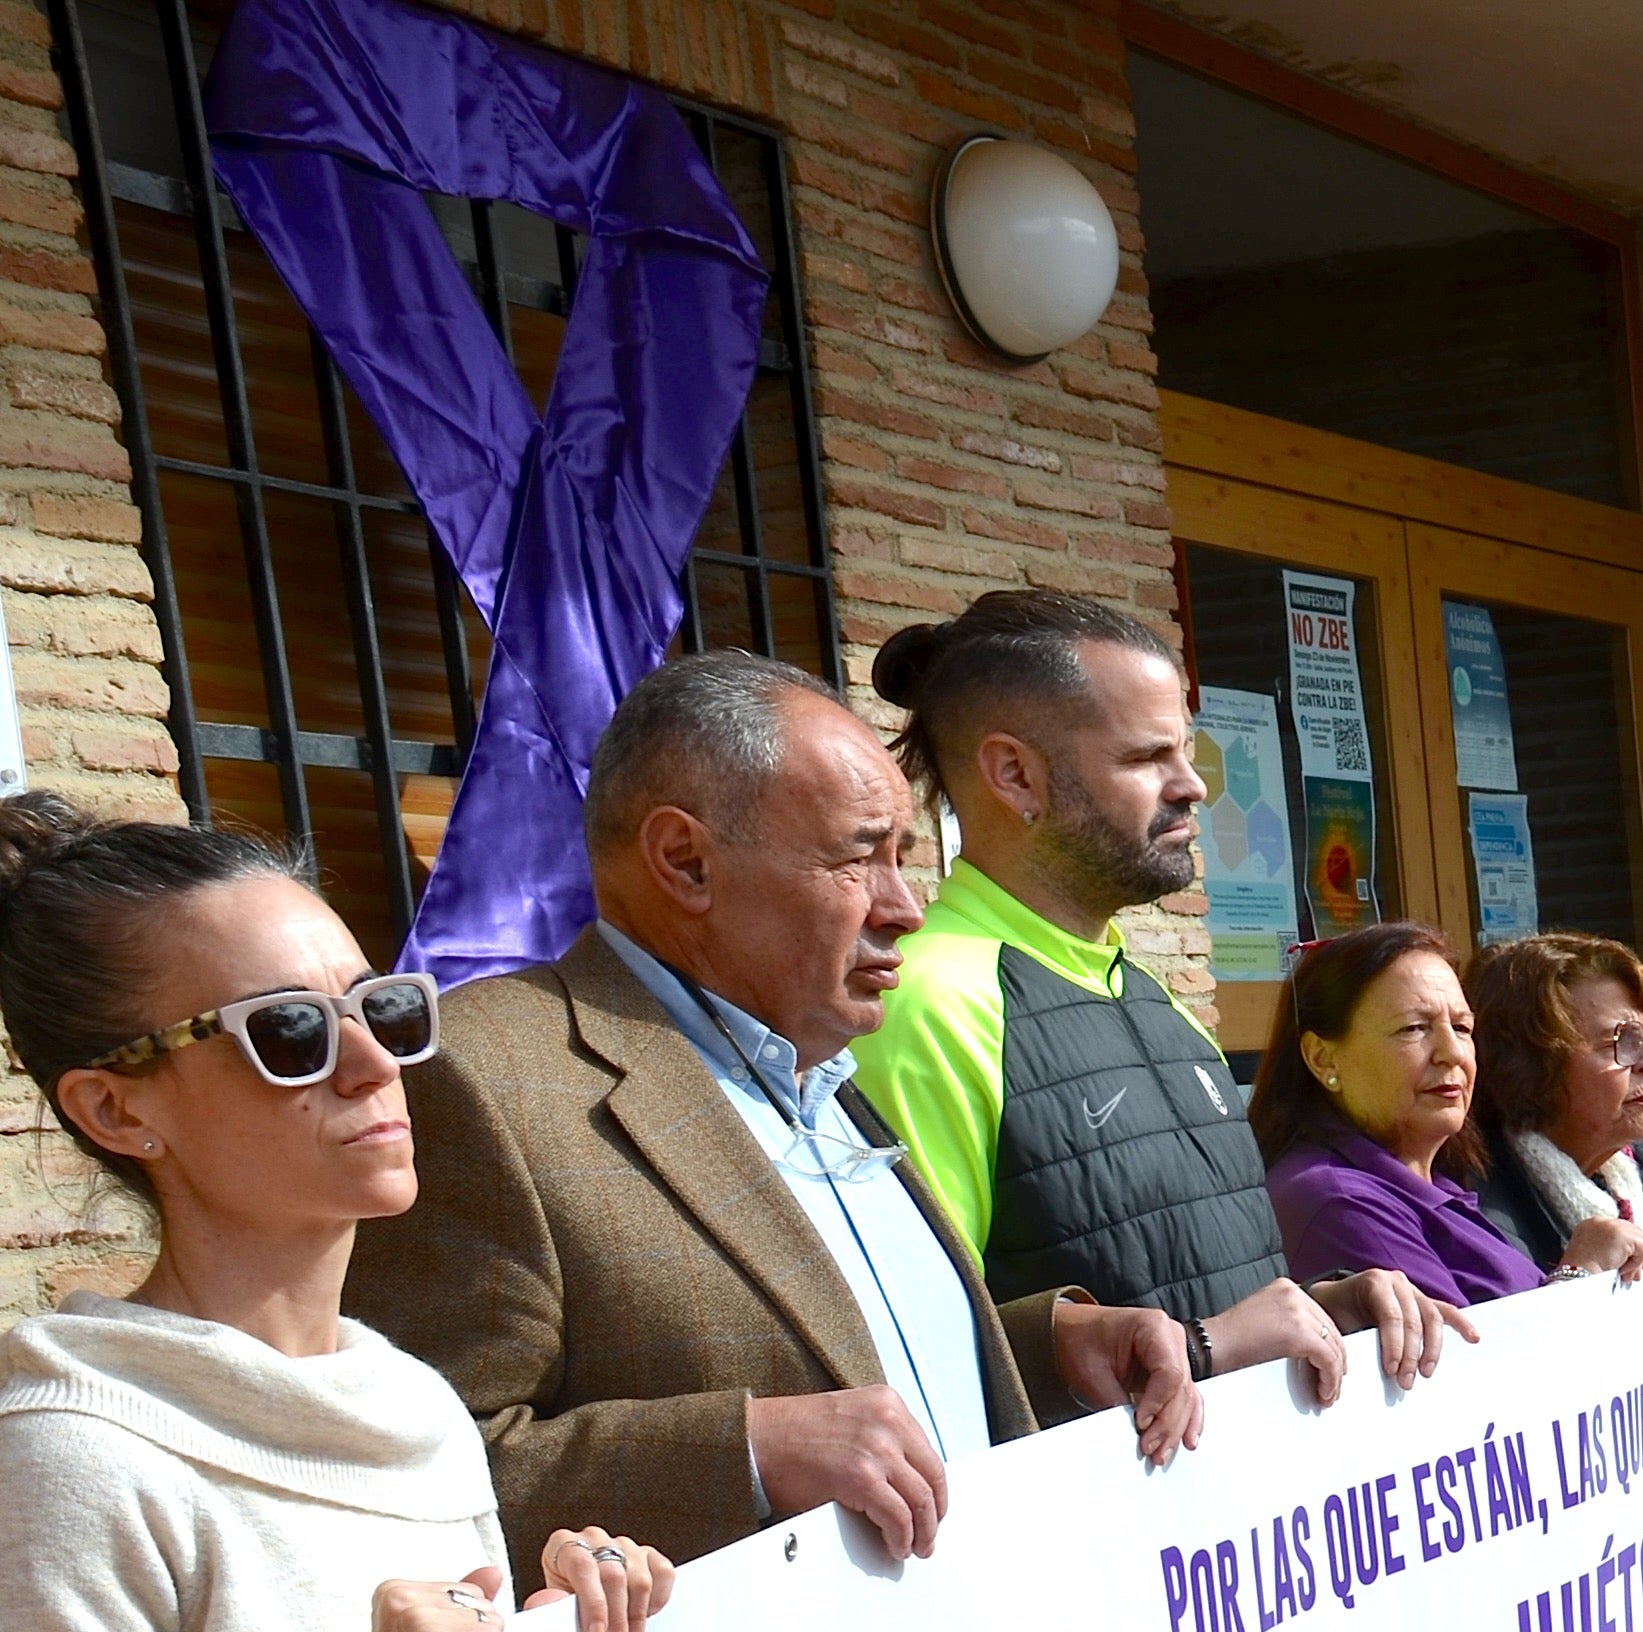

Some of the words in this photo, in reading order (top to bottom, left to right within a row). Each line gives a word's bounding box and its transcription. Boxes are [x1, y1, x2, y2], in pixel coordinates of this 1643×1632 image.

[1291, 612, 1313, 647] NO
[1318, 616, 1350, 652] ZBE
[1324, 1474, 1406, 1610] QUE
[1412, 1422, 1548, 1563] ESTÁN,
[1552, 1405, 1608, 1511] LAS
